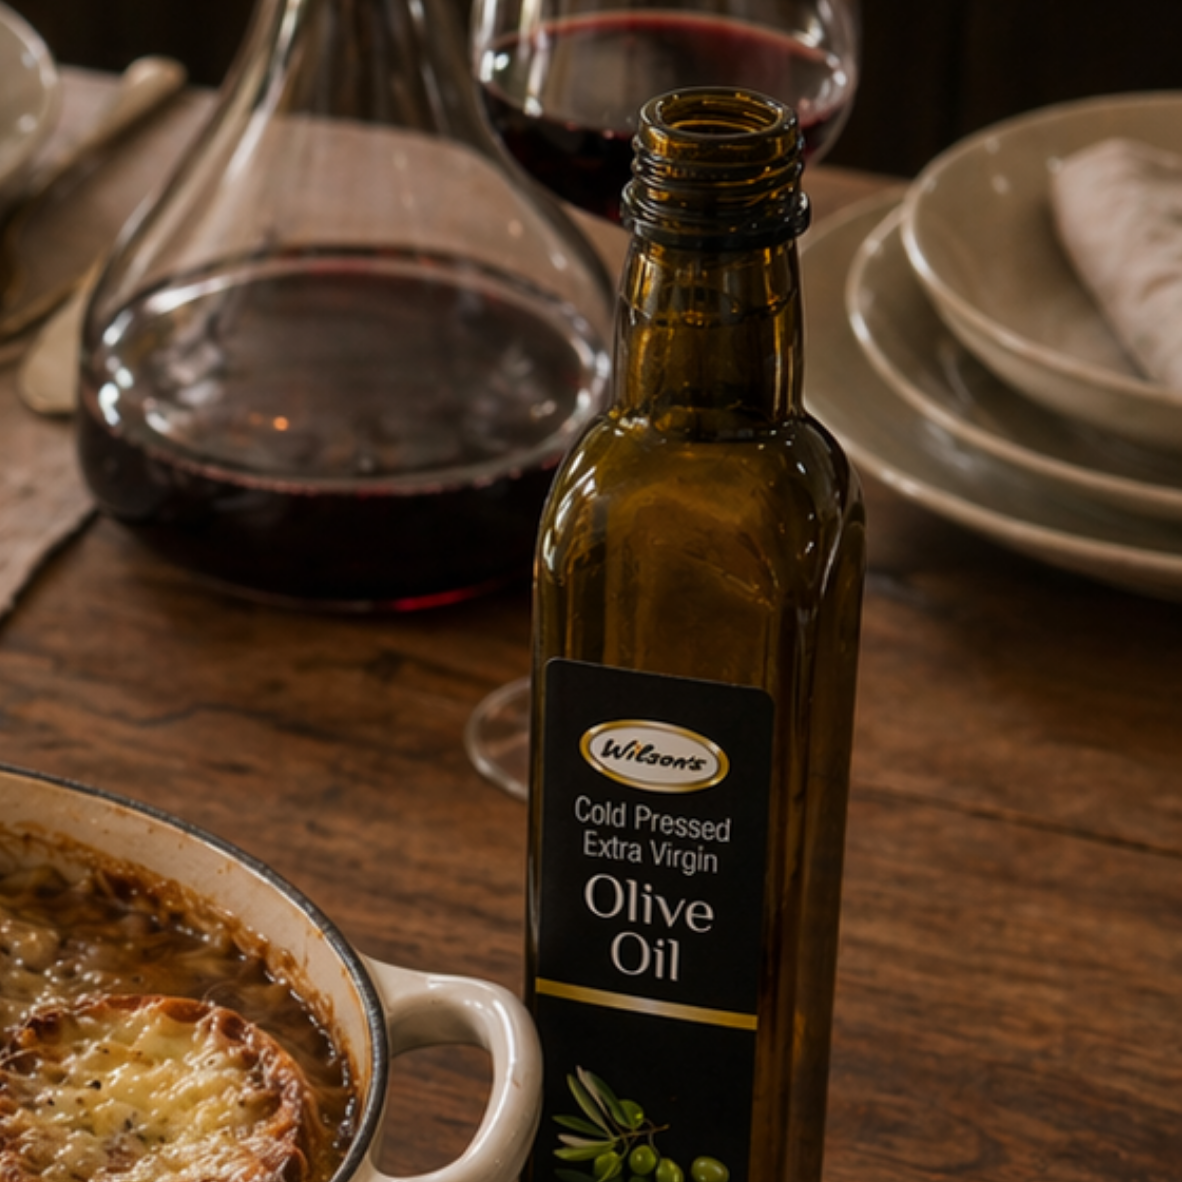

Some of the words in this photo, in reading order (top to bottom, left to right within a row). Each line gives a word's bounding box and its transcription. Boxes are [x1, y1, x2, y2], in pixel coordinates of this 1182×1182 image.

[601, 739, 707, 772] Wilson's
[575, 795, 626, 828] Cold
[634, 804, 731, 842] Pressed
[583, 830, 642, 864] Extra
[650, 840, 718, 876] Virgin
[584, 873, 714, 933] Olive
[611, 931, 679, 981] Oil
